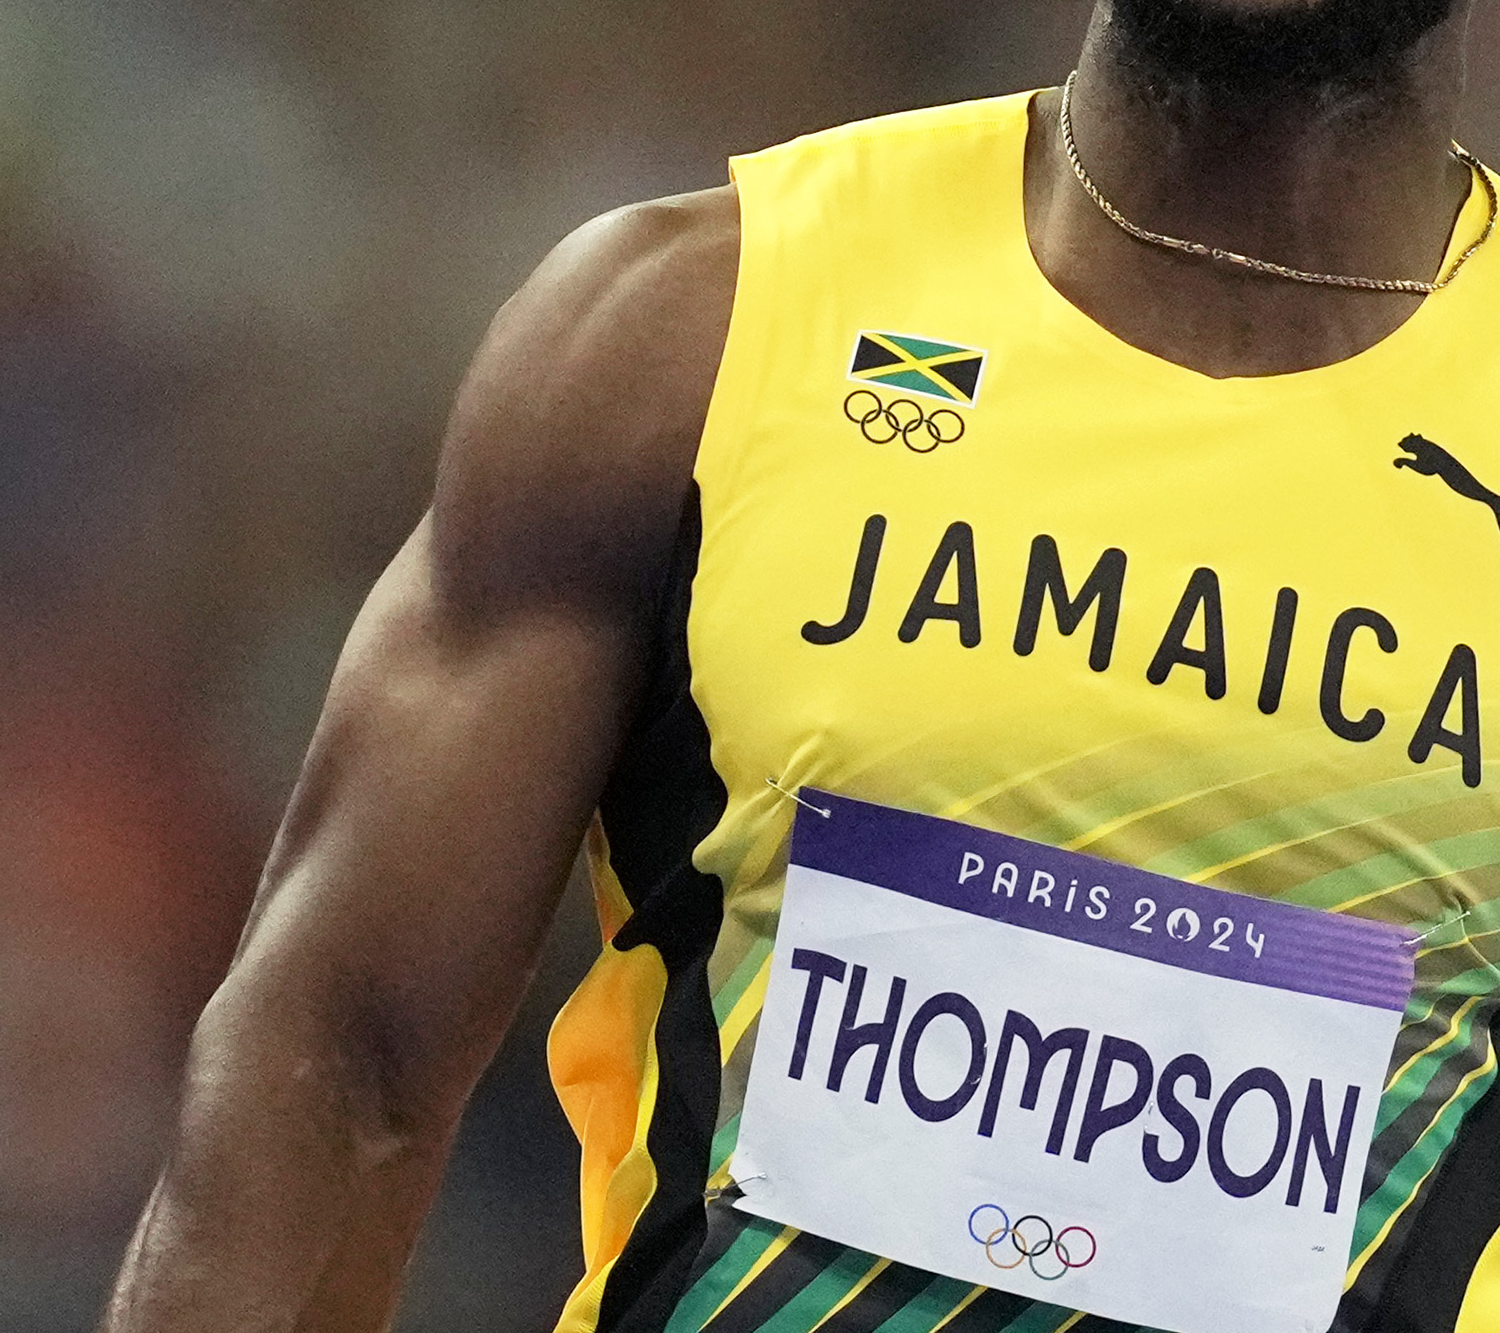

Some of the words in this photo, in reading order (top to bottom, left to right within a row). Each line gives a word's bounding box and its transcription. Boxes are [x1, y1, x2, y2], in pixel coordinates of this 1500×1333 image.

[800, 513, 1483, 789] JAMAICA
[957, 851, 1111, 921] PARIS
[1129, 897, 1266, 959] 2024
[787, 947, 1361, 1215] THOMPSON
